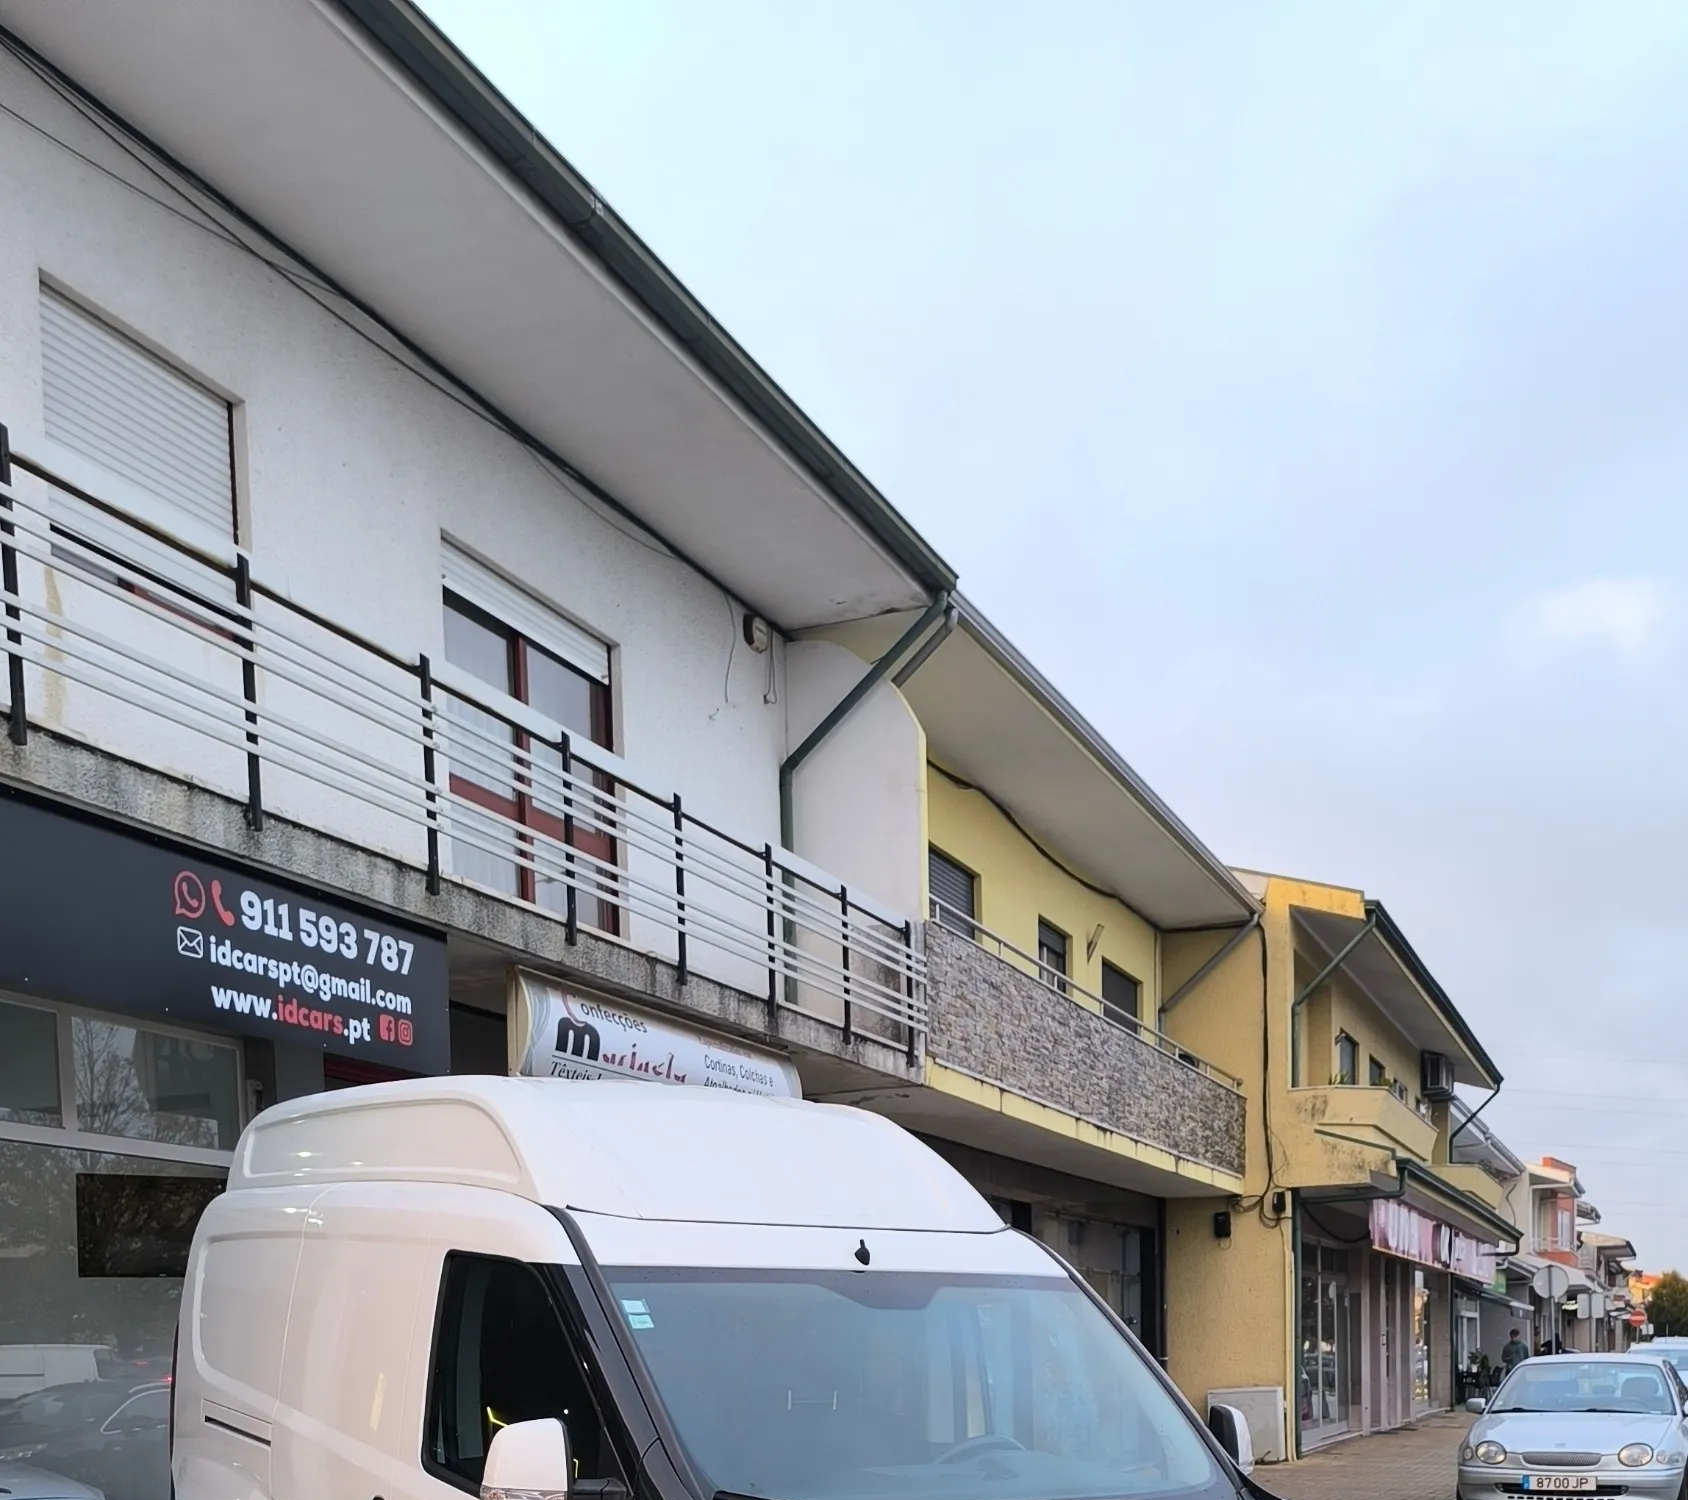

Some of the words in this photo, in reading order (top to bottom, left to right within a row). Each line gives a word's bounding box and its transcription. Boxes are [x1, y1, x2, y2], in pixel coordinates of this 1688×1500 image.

[240, 890, 293, 941] 911
[299, 908, 358, 960] 593
[363, 928, 414, 975] 787
[209, 935, 412, 1014] idcarspt@gmail.com
[211, 985, 371, 1045] www.idcars.pt
[704, 1054, 739, 1080] Cortinas,
[739, 1064, 768, 1087] Colchas
[768, 1076, 774, 1088] e
[1536, 1477, 1570, 1489] 8700
